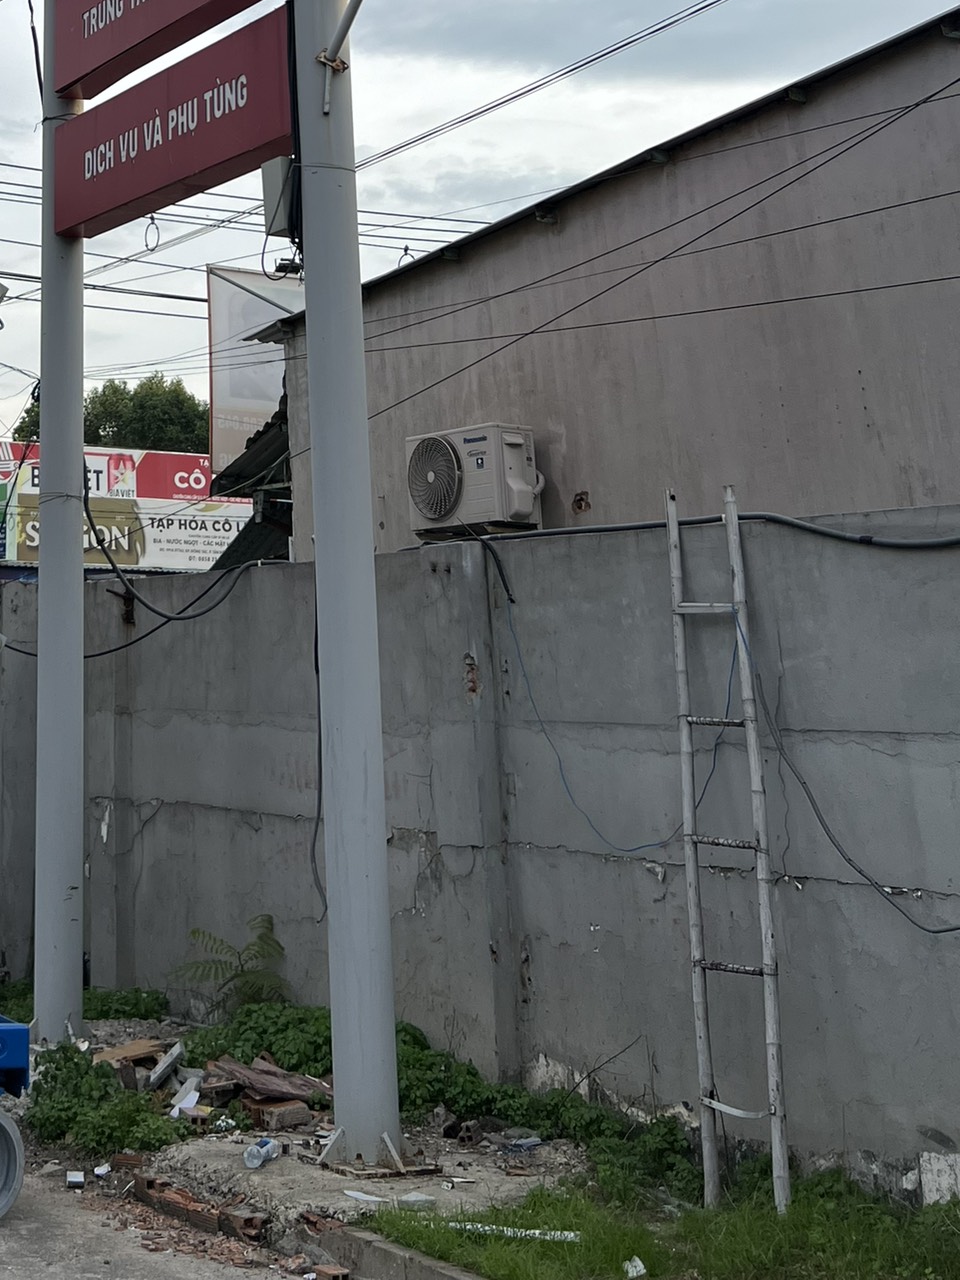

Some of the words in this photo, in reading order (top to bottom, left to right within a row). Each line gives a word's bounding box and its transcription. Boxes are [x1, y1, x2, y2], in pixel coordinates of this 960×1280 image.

[84, 138, 114, 182] DỊCH
[120, 126, 138, 164] VỤ
[144, 108, 162, 152] VÀ
[168, 97, 198, 140] PHỤ
[204, 74, 247, 122] TÙNG
[174, 468, 206, 489] CÔ
[148, 517, 174, 533] TẠP
[178, 516, 208, 531] HÓA
[212, 517, 232, 532] CÔ
